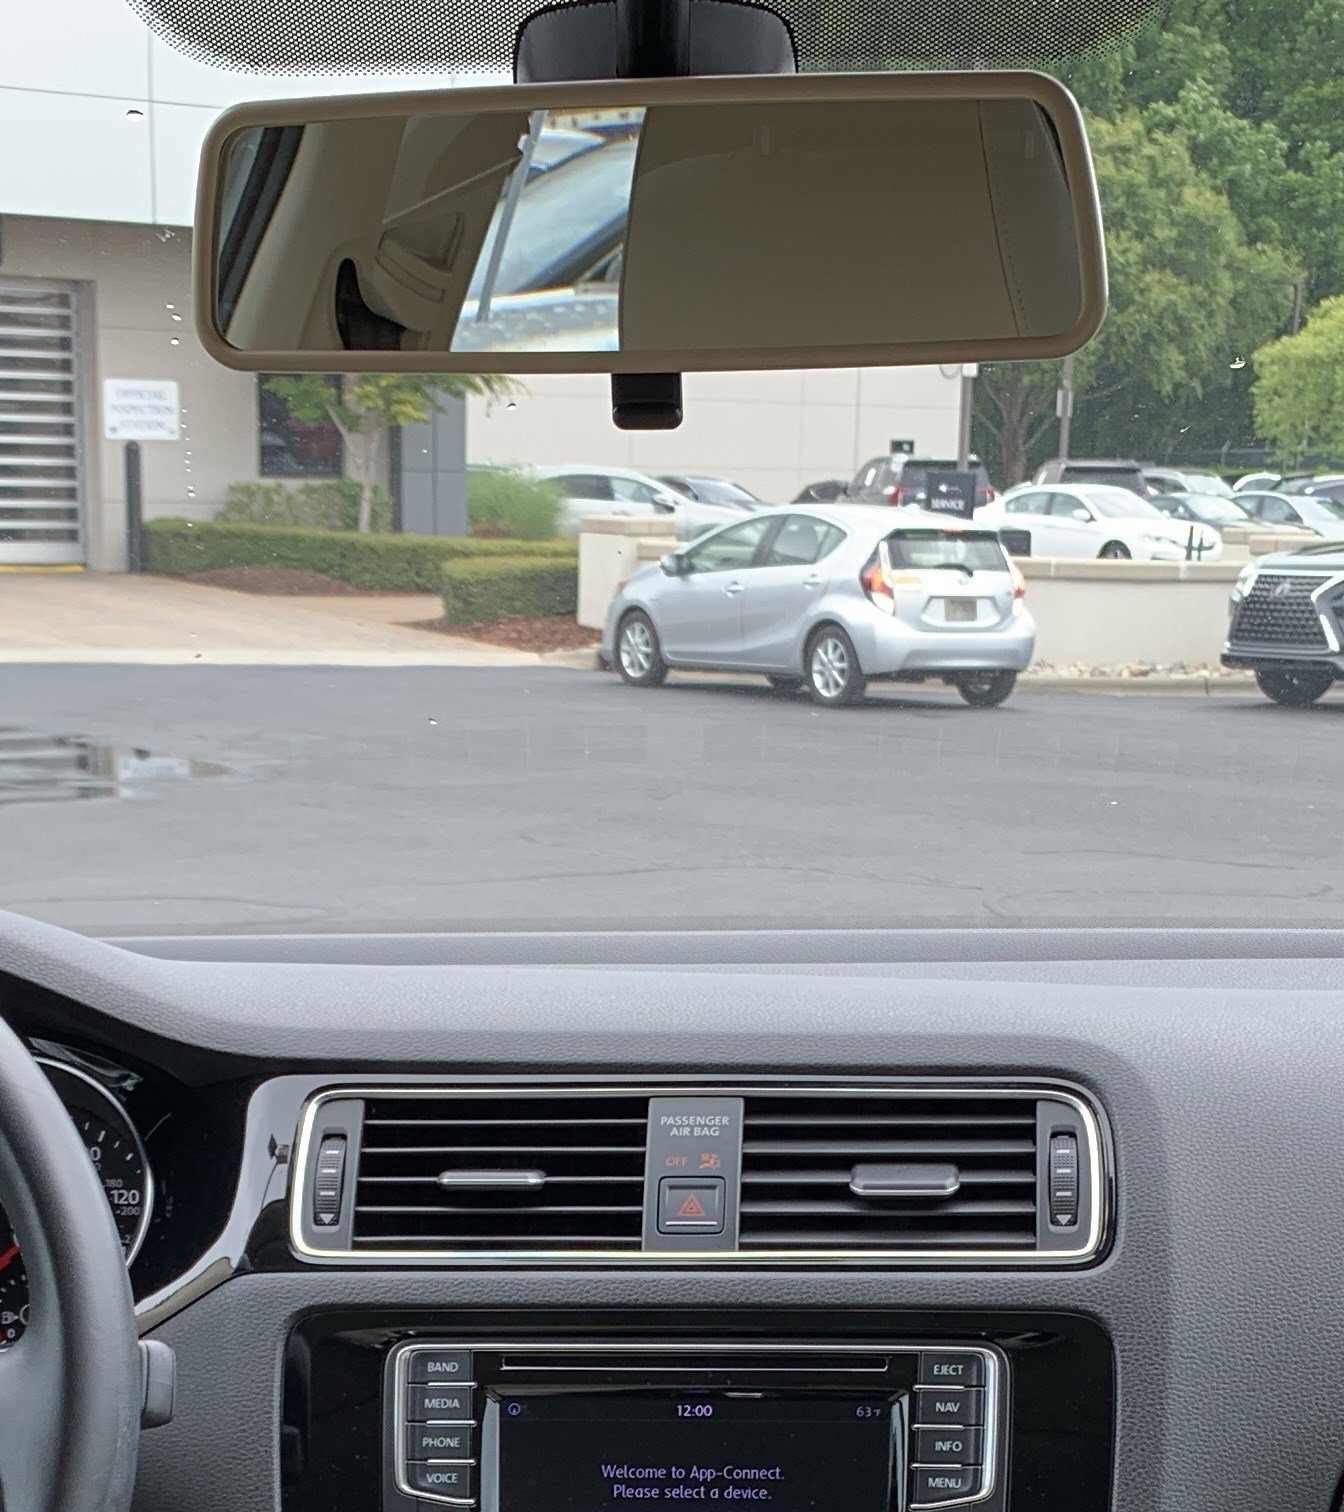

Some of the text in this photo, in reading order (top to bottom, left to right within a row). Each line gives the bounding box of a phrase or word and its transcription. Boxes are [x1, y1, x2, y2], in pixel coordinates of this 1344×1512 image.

[660, 1116, 730, 1126] PASSENGER
[670, 1127, 719, 1136] AIR BAG
[665, 1156, 687, 1166] OFF
[110, 1189, 139, 1204] 120
[427, 1362, 458, 1372] BAND
[933, 1365, 964, 1375] EJECT
[424, 1398, 460, 1408] MEDIA
[936, 1402, 960, 1412] NAV
[677, 1405, 712, 1417] 12:00
[422, 1437, 459, 1447] PHONE
[935, 1441, 962, 1452] INFO
[426, 1473, 457, 1483] VOICE
[601, 1465, 785, 1481] Welcome to App-Connect.
[928, 1478, 961, 1488] MENU
[613, 1484, 772, 1500] Please select a device.
